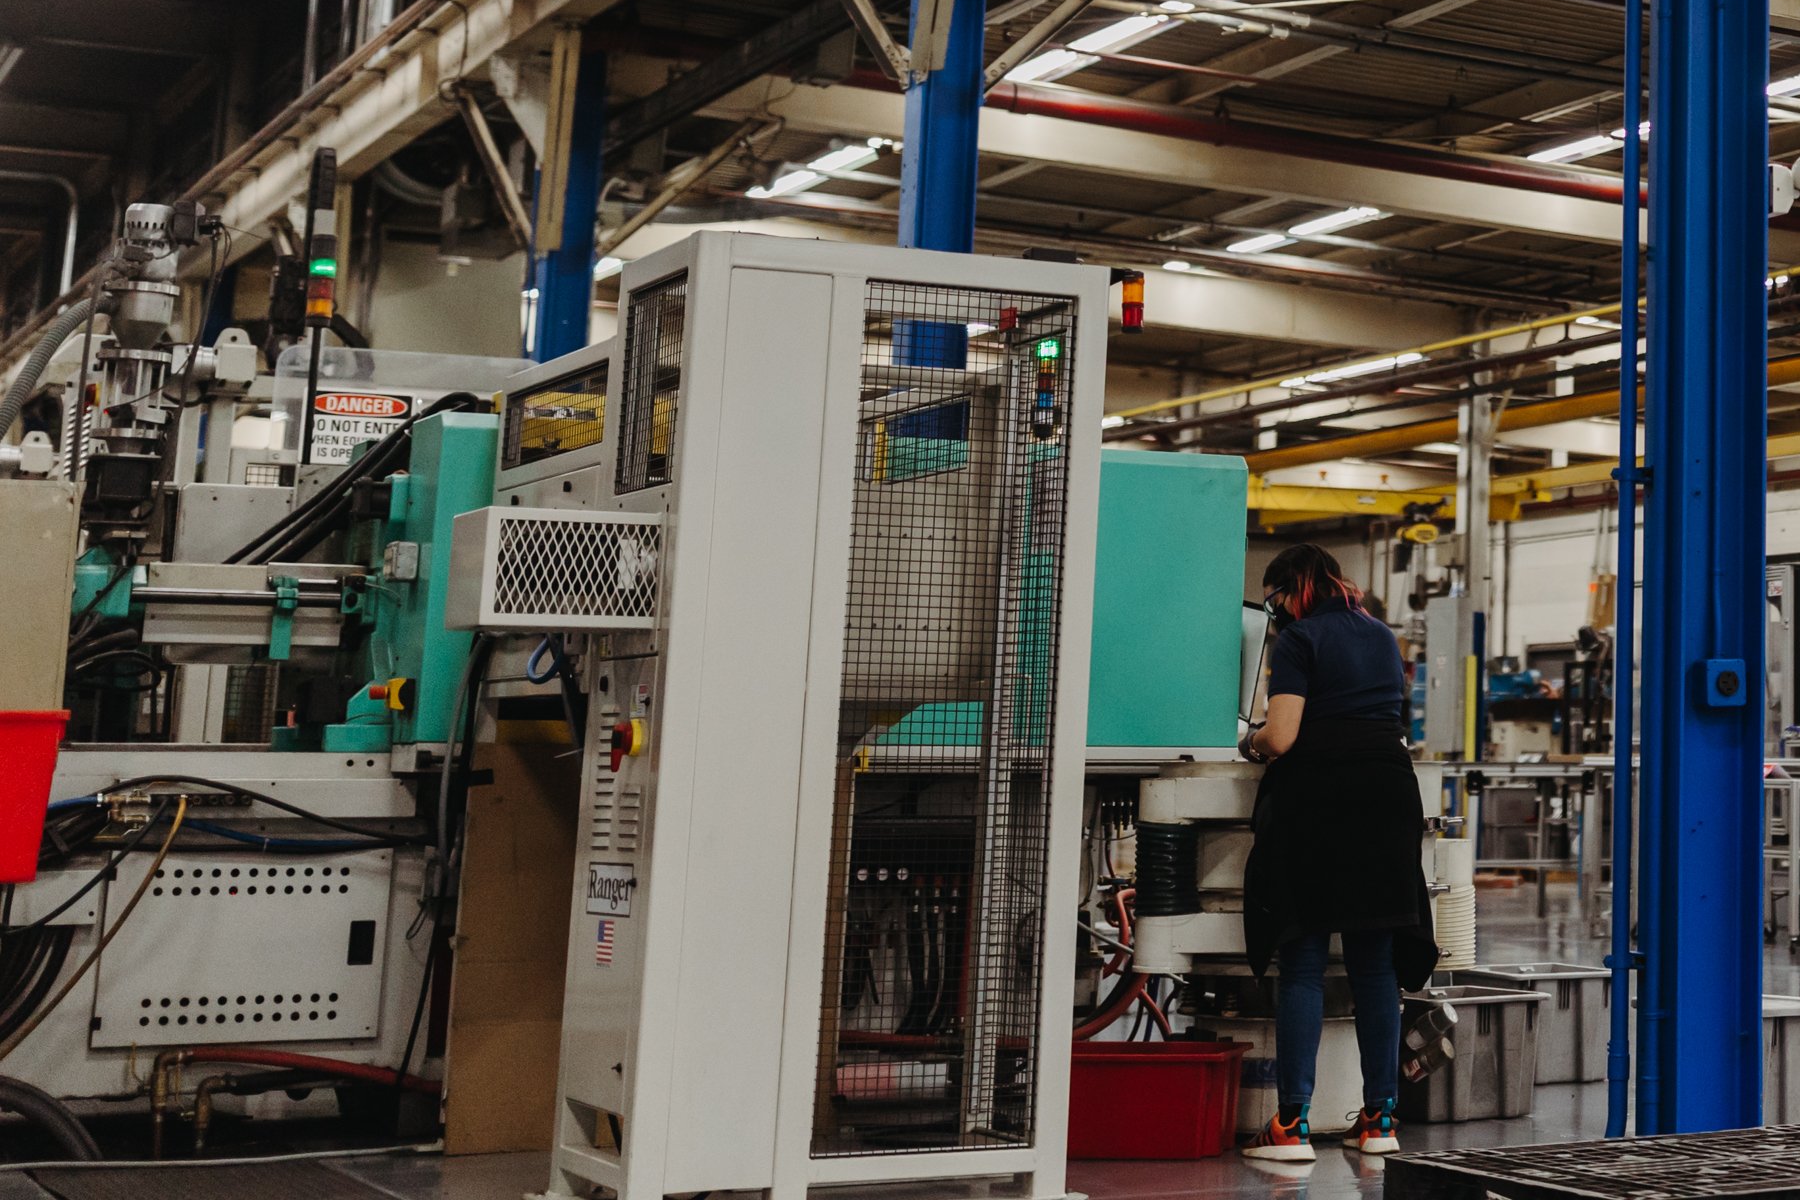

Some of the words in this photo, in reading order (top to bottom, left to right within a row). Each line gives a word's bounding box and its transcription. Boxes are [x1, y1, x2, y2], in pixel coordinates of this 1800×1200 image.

[325, 396, 394, 414] DANGER
[313, 418, 326, 431] O
[331, 420, 360, 433] NOT
[364, 421, 399, 435] ENTE
[312, 434, 339, 445] HEN
[317, 448, 327, 457] IS
[331, 448, 352, 458] OPE
[588, 869, 630, 910] Ranger
